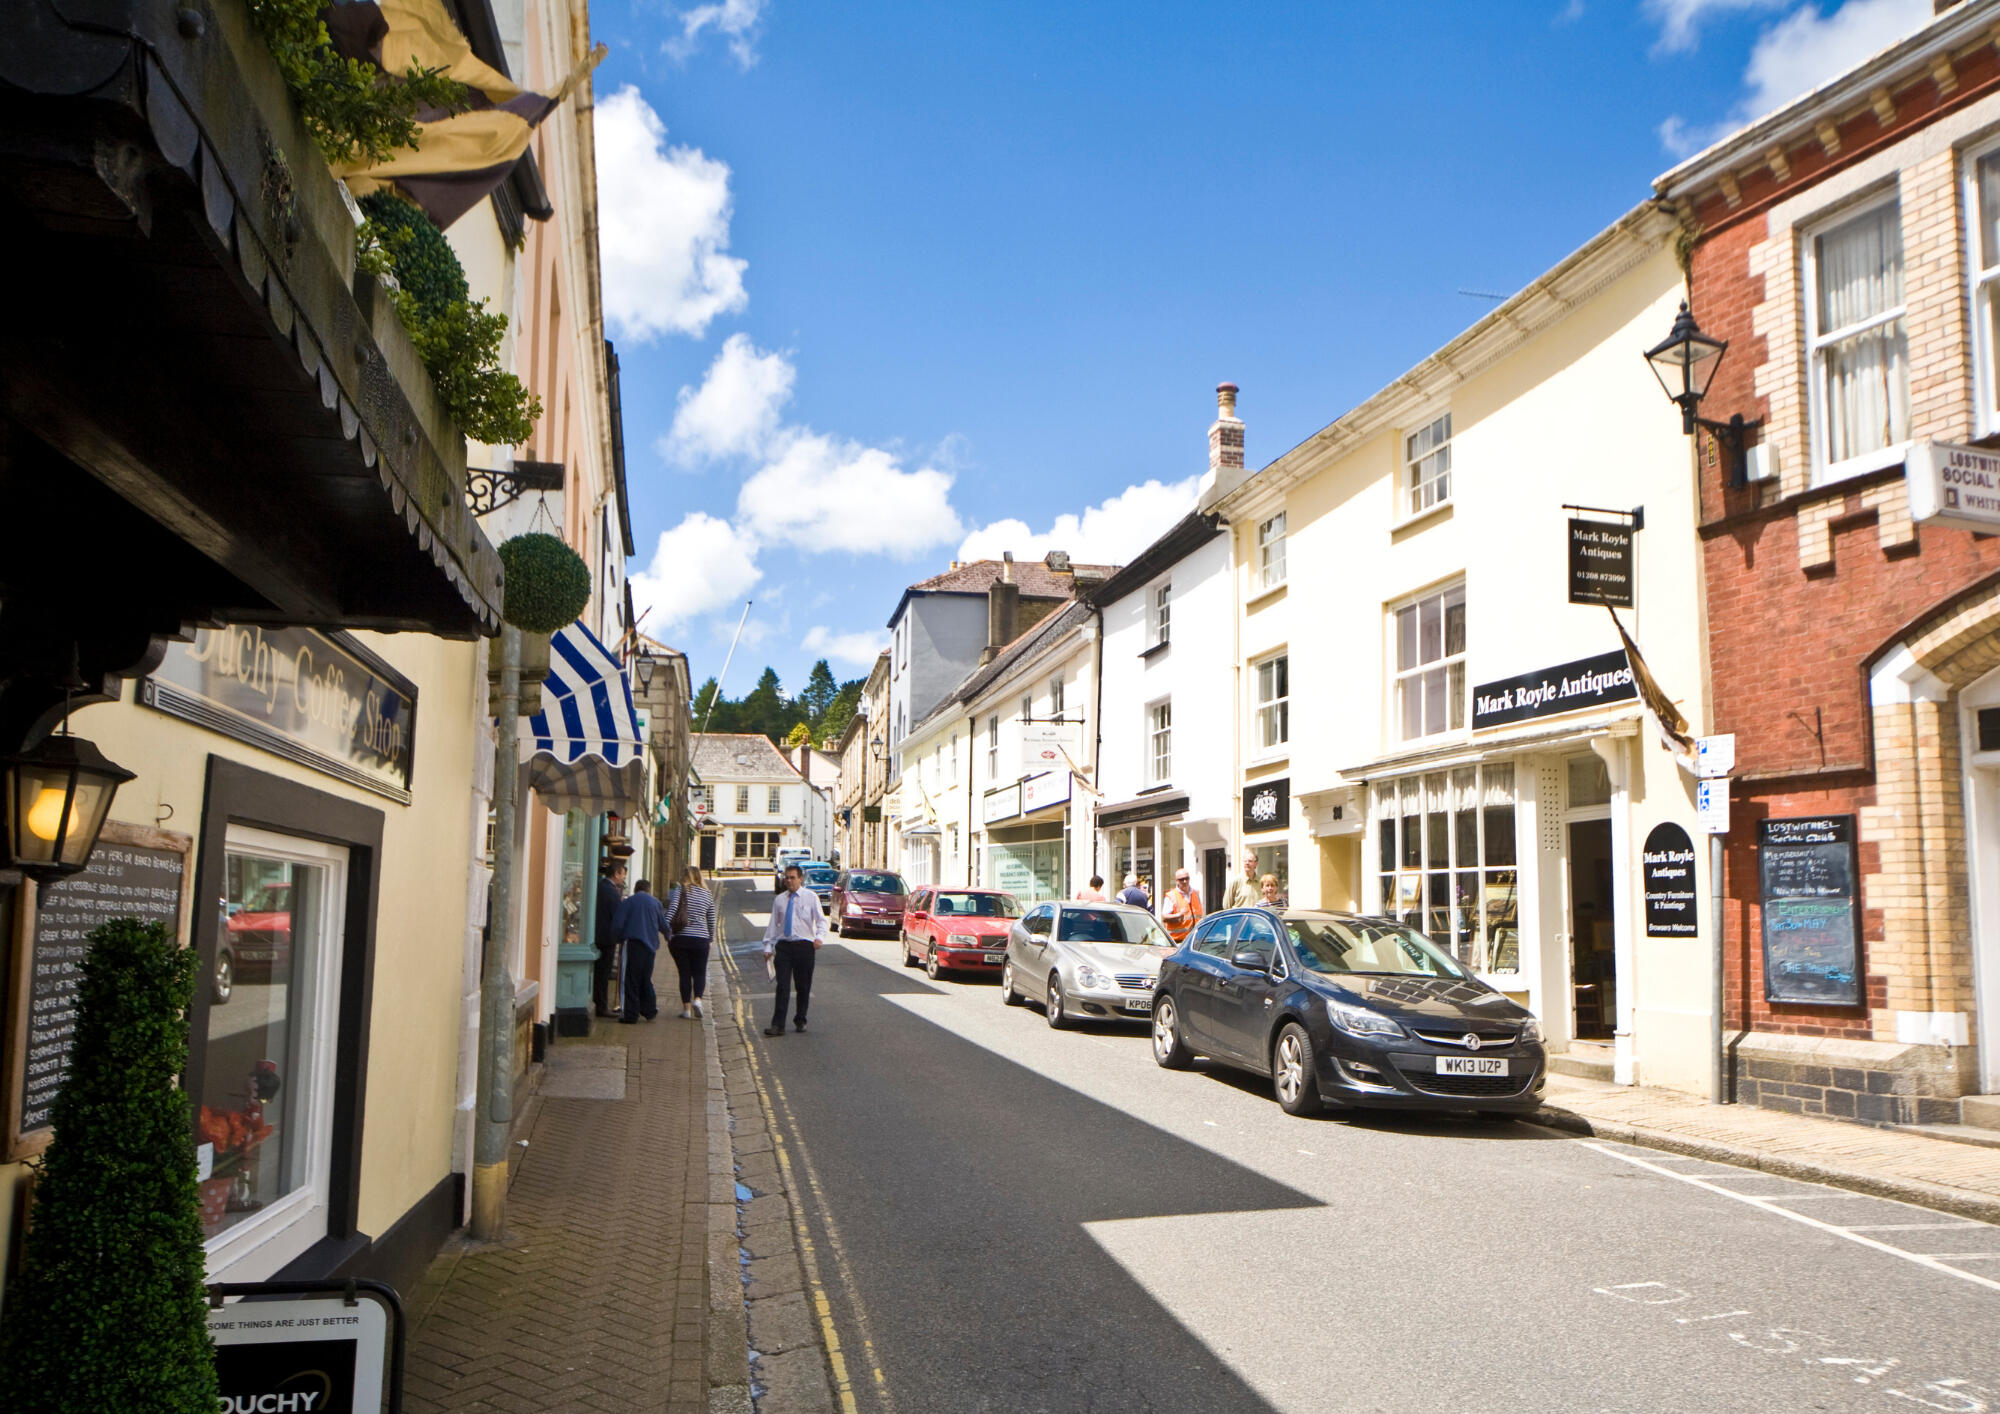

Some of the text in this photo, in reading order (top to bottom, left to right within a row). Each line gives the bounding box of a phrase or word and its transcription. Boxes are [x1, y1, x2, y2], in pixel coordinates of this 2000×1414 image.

[1950, 451, 2000, 473] LOSTWIT
[1942, 466, 1994, 489] SOCIAL
[1573, 529, 1629, 547] Mark Royle
[1580, 545, 1623, 560] Antiques
[1476, 666, 1633, 716] Mark Royle Antiques
[294, 645, 361, 739] Coffee
[363, 689, 401, 761] Shop
[1767, 821, 1841, 833] LOSTWITHIEL
[1805, 832, 1836, 843] CLUB
[1644, 848, 1695, 864] Mark Royle
[1651, 867, 1687, 880] Antiques
[1672, 923, 1696, 932] Welcome
[1129, 999, 1152, 1010] KP06
[1445, 1058, 1502, 1074] WK13 UZP
[207, 1316, 360, 1331] SOME THINGS ARE JUST BETTER
